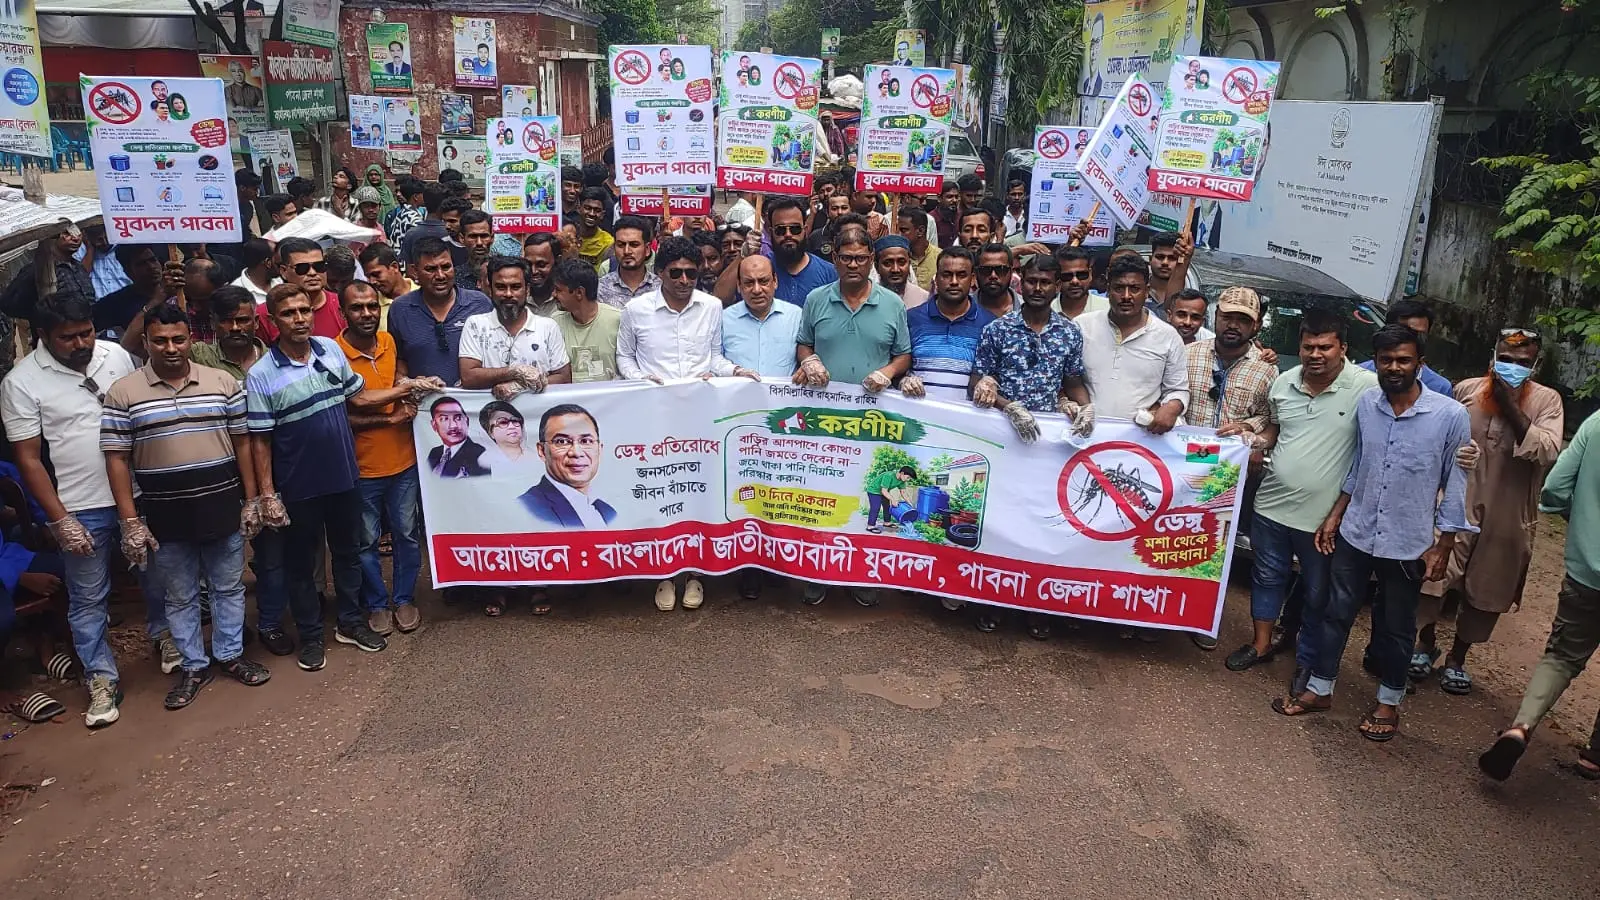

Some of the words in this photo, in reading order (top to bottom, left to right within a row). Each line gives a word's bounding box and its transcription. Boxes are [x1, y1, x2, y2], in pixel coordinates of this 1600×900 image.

[756, 106, 786, 120] করণীয়
[1200, 111, 1232, 125] করণীয়
[623, 162, 667, 181] যুবদল
[671, 162, 711, 175] পাবনা
[723, 170, 765, 186] যুবদল
[768, 172, 806, 188] পাবনা
[864, 174, 901, 190] যুবদল
[903, 175, 937, 188] পাবনা
[1085, 157, 1114, 193] যুবদল
[1112, 188, 1137, 220] পাবনা
[1156, 171, 1201, 190] যুবদল
[1205, 177, 1246, 195] পাবনা
[628, 197, 664, 212] যুবদল
[669, 196, 703, 210] পাবনা
[112, 216, 175, 238] যুবদল
[180, 216, 234, 231] পাবনা
[492, 216, 522, 231] যুবদল
[524, 216, 553, 227] পাবনা
[1032, 223, 1071, 238] যুবদল
[855, 393, 879, 405] রাহিম
[817, 410, 906, 441] করণীয়
[614, 444, 648, 463] ডেঙ্গু
[651, 436, 720, 457] প্রতিরোধে
[739, 433, 769, 446] বাড়ির
[772, 438, 818, 451] আশপাশে
[821, 444, 862, 456] কোথাও
[739, 444, 762, 457] পানি
[765, 449, 798, 460] জমতে
[801, 453, 835, 466] দেবেন
[635, 461, 702, 480] জনসচেতনতা
[739, 458, 758, 467] জমে
[761, 460, 782, 471] থাকা
[785, 461, 806, 473] পানি
[808, 464, 845, 478] নিয়মিত
[631, 484, 665, 501] জীবন
[668, 480, 707, 495] বাঁচাতে
[758, 489, 767, 498] ৩
[769, 487, 793, 502] দিনে
[795, 494, 837, 509] একবার
[659, 502, 684, 518] পারে
[1154, 512, 1205, 533] ডেঙ্গু
[1144, 536, 1171, 549] মশা
[1173, 534, 1209, 547] থেকে
[1151, 548, 1208, 565] সাবধান!
[450, 544, 571, 573] আয়োজনে
[595, 532, 705, 569] বাংলাদেশ
[711, 521, 857, 573] জাতীয়তাবাদী
[958, 561, 1031, 599] পাবনা
[1037, 576, 1104, 608] জেলা
[1111, 583, 1173, 616] শাখা
